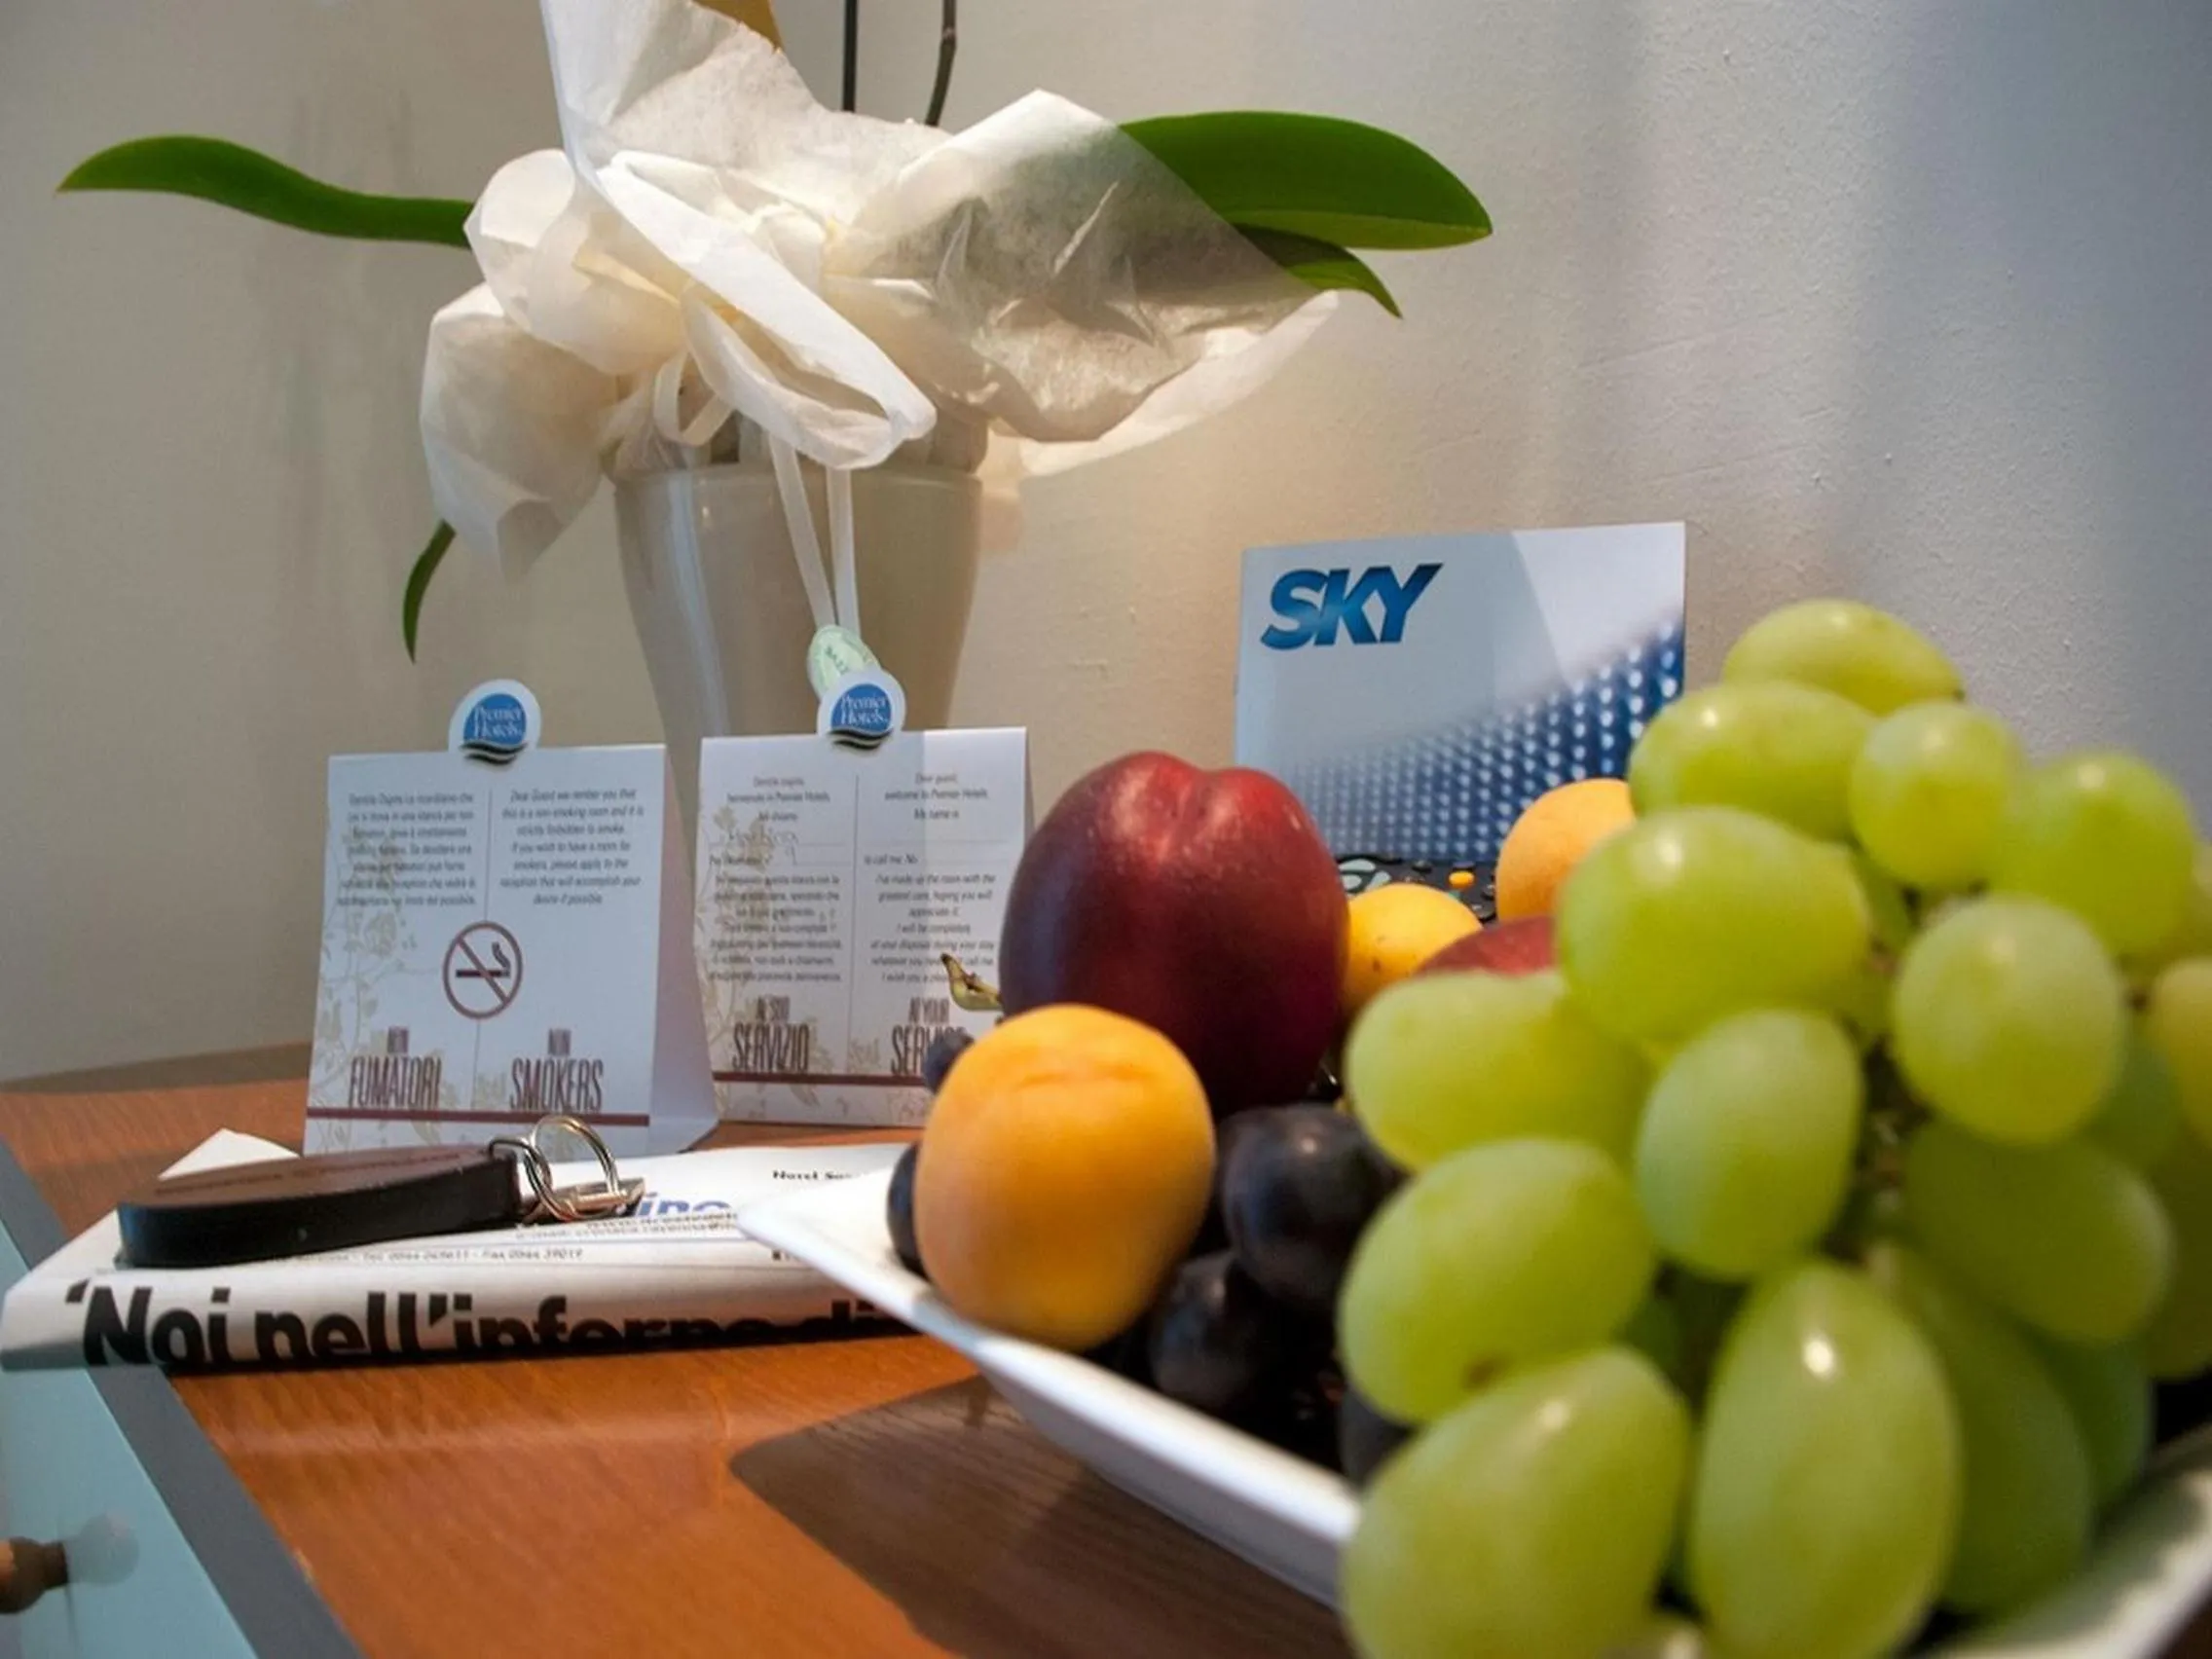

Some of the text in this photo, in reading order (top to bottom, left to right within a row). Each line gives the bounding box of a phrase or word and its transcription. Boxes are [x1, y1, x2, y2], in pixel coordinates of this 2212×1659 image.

[1261, 562, 1444, 651] SKY
[841, 692, 888, 710] Premier
[732, 1022, 809, 1073] SERVIZIO
[348, 1054, 442, 1110] FUMATORI
[508, 1056, 604, 1113] SMOKERS
